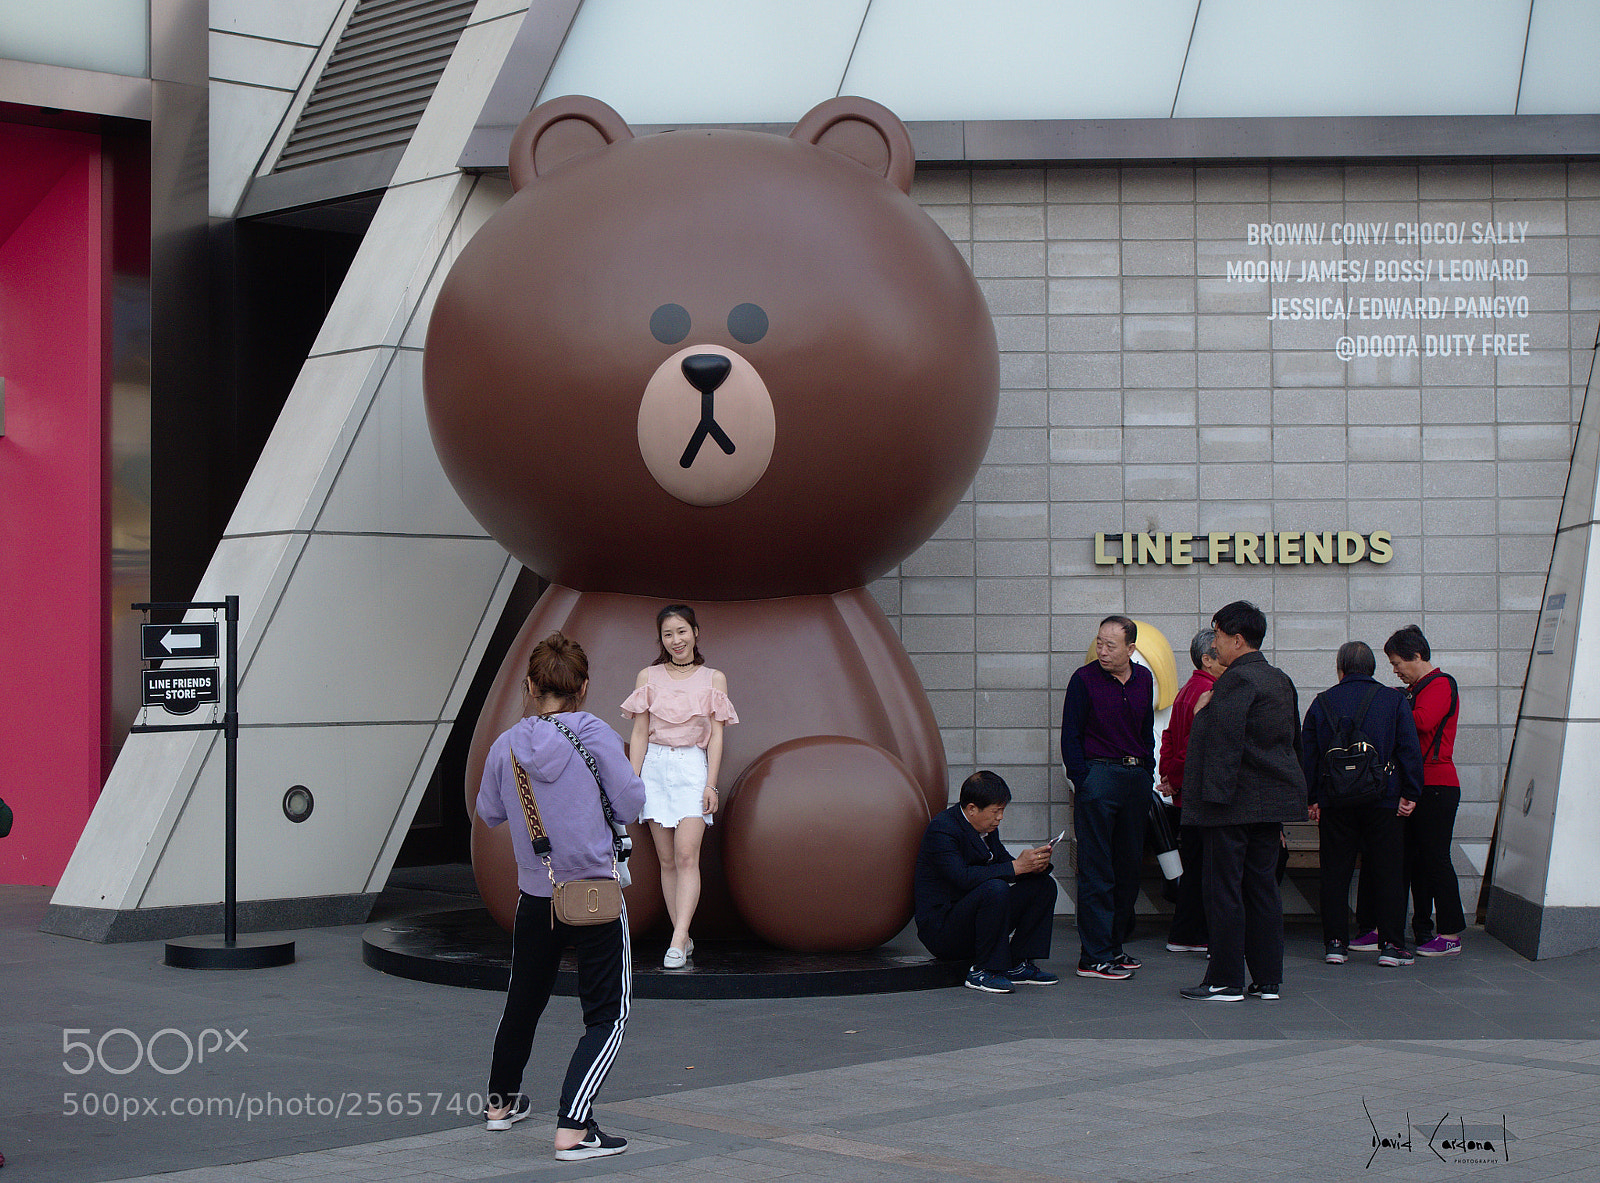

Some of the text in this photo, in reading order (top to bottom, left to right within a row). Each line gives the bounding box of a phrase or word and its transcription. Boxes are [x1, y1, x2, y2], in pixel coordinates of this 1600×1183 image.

[1247, 221, 1529, 246] BROWN/ CONY/ CHOCO/ SALLY
[1226, 258, 1529, 283] MOON/ JAMES/ BOSS/ LEONARD
[1267, 296, 1530, 321] JESSICA/ EDWARD/ PANGYO
[1336, 334, 1530, 361] @DOOTA DUTY FREE
[1094, 531, 1394, 565] LINE FRIENDS
[149, 677, 212, 689] LINE FRIENDS
[165, 689, 196, 699] STORE
